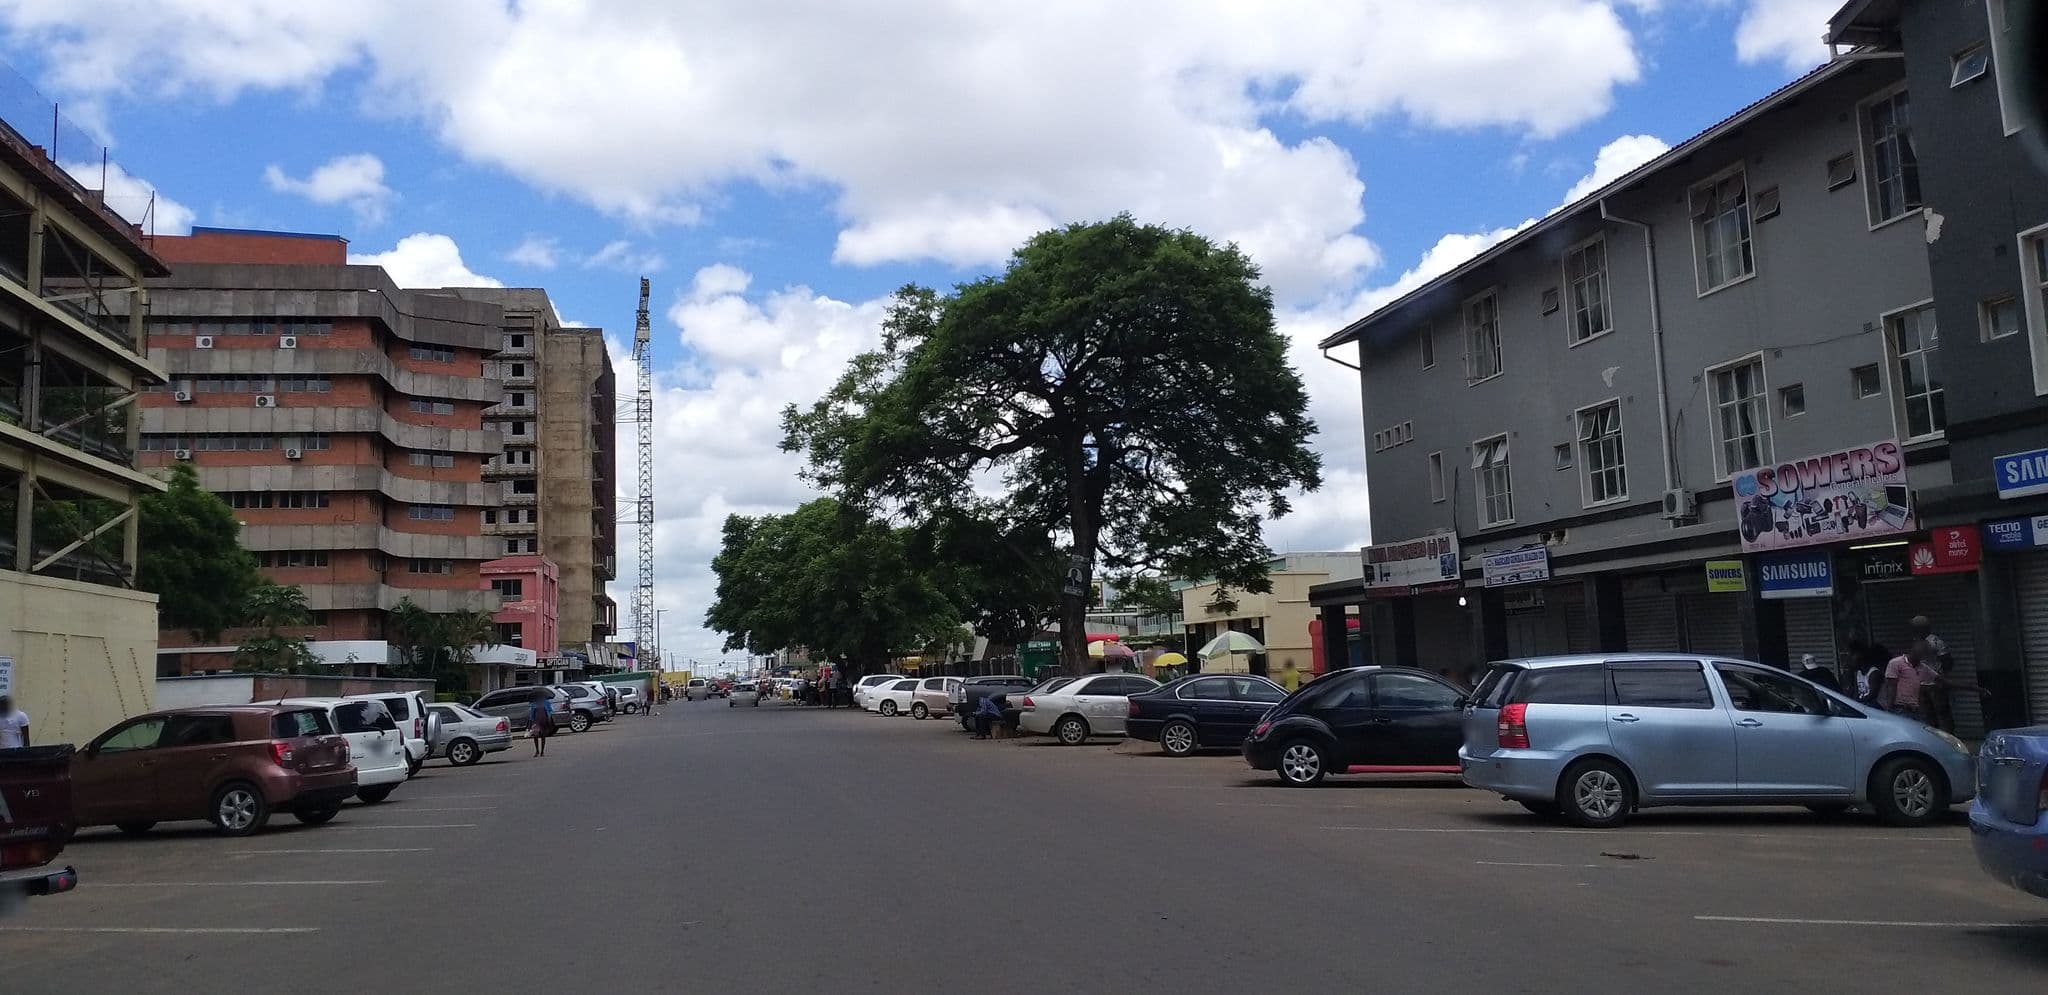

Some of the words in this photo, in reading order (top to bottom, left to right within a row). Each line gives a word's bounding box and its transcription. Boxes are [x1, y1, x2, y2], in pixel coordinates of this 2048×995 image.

[1757, 442, 1901, 497] SOWERS
[1829, 476, 1861, 491] General
[1863, 472, 1897, 485] Dealers
[1989, 521, 2021, 534] TECNO
[1709, 569, 1742, 579] SOWERS
[1763, 561, 1827, 581] SAMSUNG
[546, 658, 569, 666] OPTICIAN
